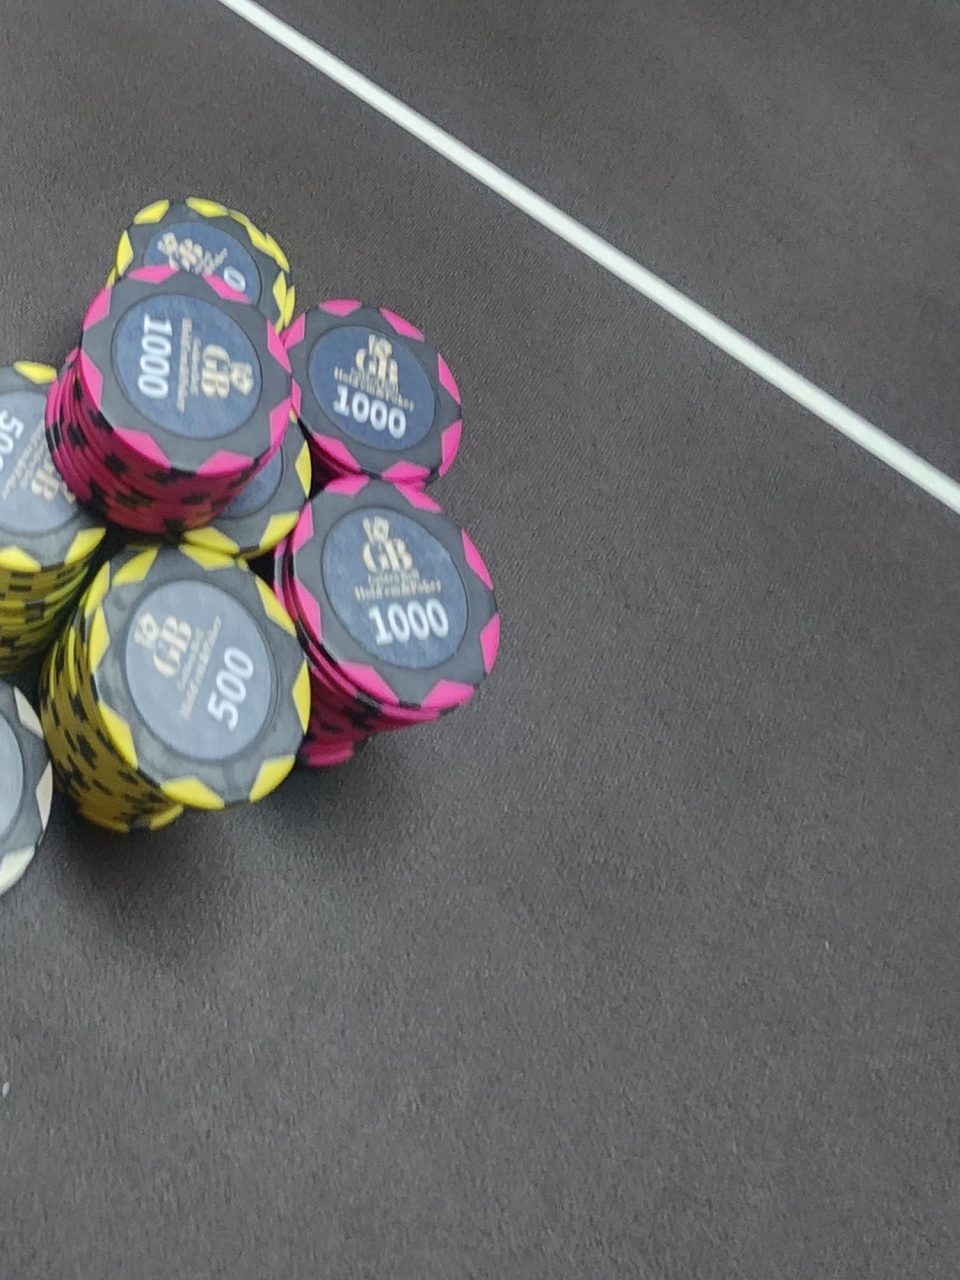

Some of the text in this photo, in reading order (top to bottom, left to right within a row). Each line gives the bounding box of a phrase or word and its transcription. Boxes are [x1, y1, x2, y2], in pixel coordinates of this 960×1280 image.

[138, 312, 173, 400] 1000
[333, 384, 406, 439] 1000
[153, 615, 191, 678] GB
[368, 598, 449, 645] 1000
[207, 646, 254, 732] 500
